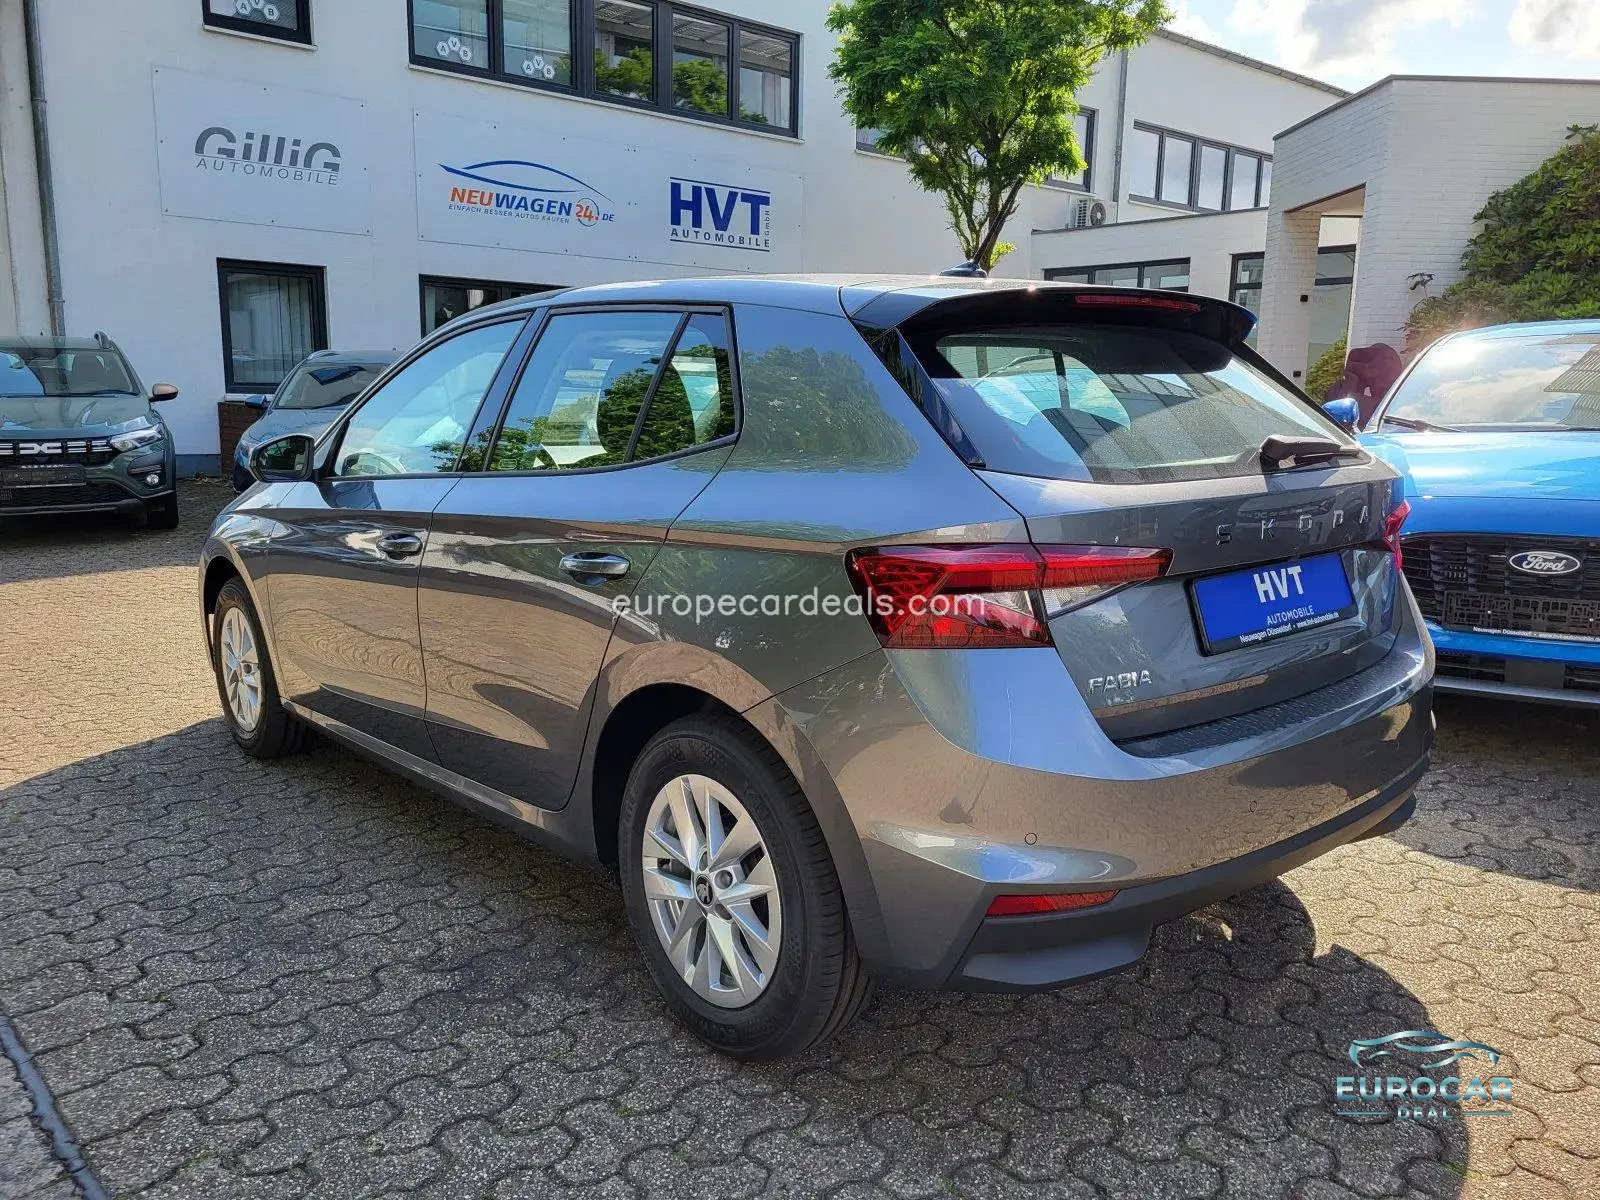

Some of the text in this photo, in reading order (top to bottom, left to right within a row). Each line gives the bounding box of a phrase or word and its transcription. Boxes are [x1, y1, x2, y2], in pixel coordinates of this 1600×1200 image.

[196, 158, 339, 186] AUTOMOBILE
[448, 203, 571, 225] EINFACH BESSER AUTOS KAUFEN
[670, 181, 770, 236] HVT
[670, 227, 770, 248] AUTOMOBILE
[1522, 554, 1567, 571] Ford
[1253, 565, 1304, 604] HVT
[1266, 605, 1315, 626] AUTOMOBILE
[1239, 627, 1268, 644] Neuwagen
[1087, 669, 1153, 694] FABIA
